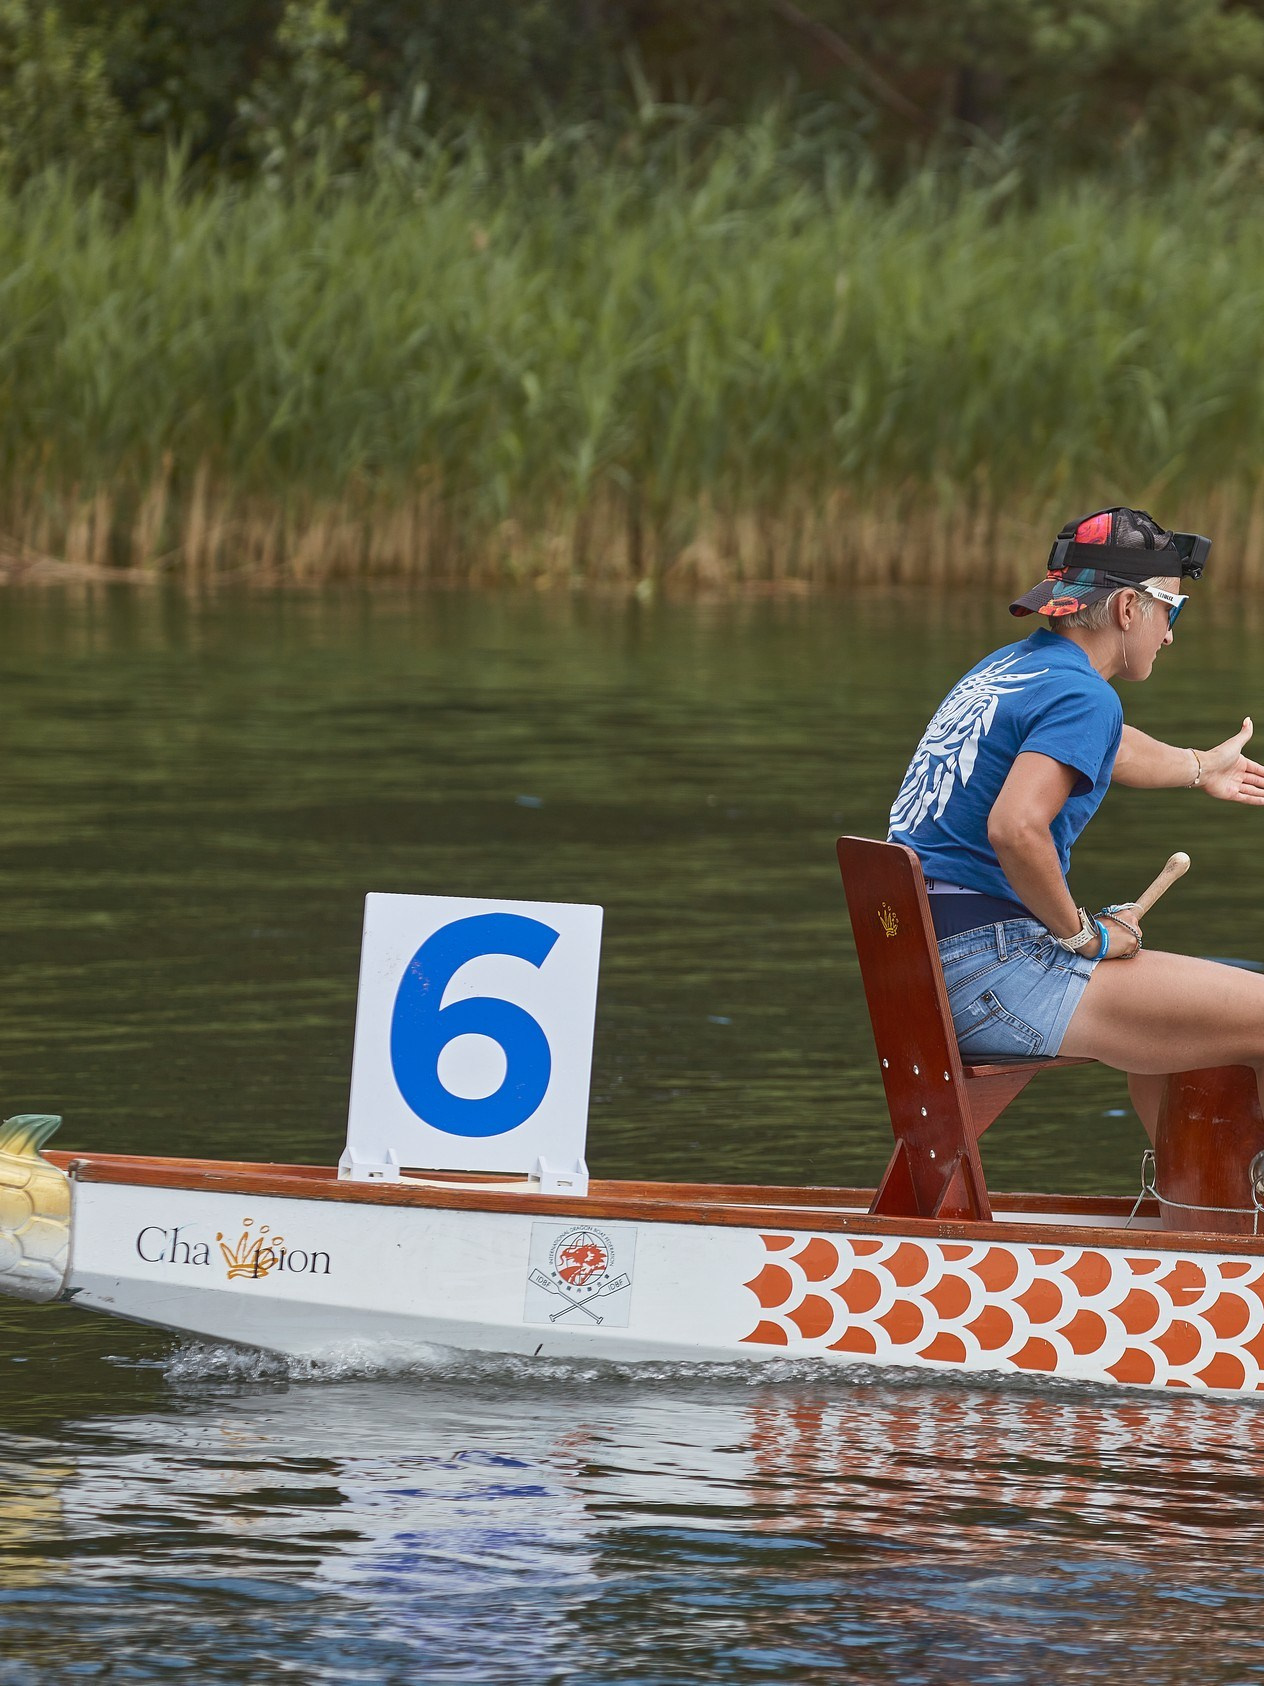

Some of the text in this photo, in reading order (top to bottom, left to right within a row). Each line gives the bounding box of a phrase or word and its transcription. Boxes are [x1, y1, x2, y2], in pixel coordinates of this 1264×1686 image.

[390, 912, 560, 1137] 6
[593, 1227, 606, 1238] BOAT
[604, 1236, 615, 1267] FEDERATION
[535, 1275, 551, 1288] IDBF
[607, 1279, 624, 1291] IDBF
